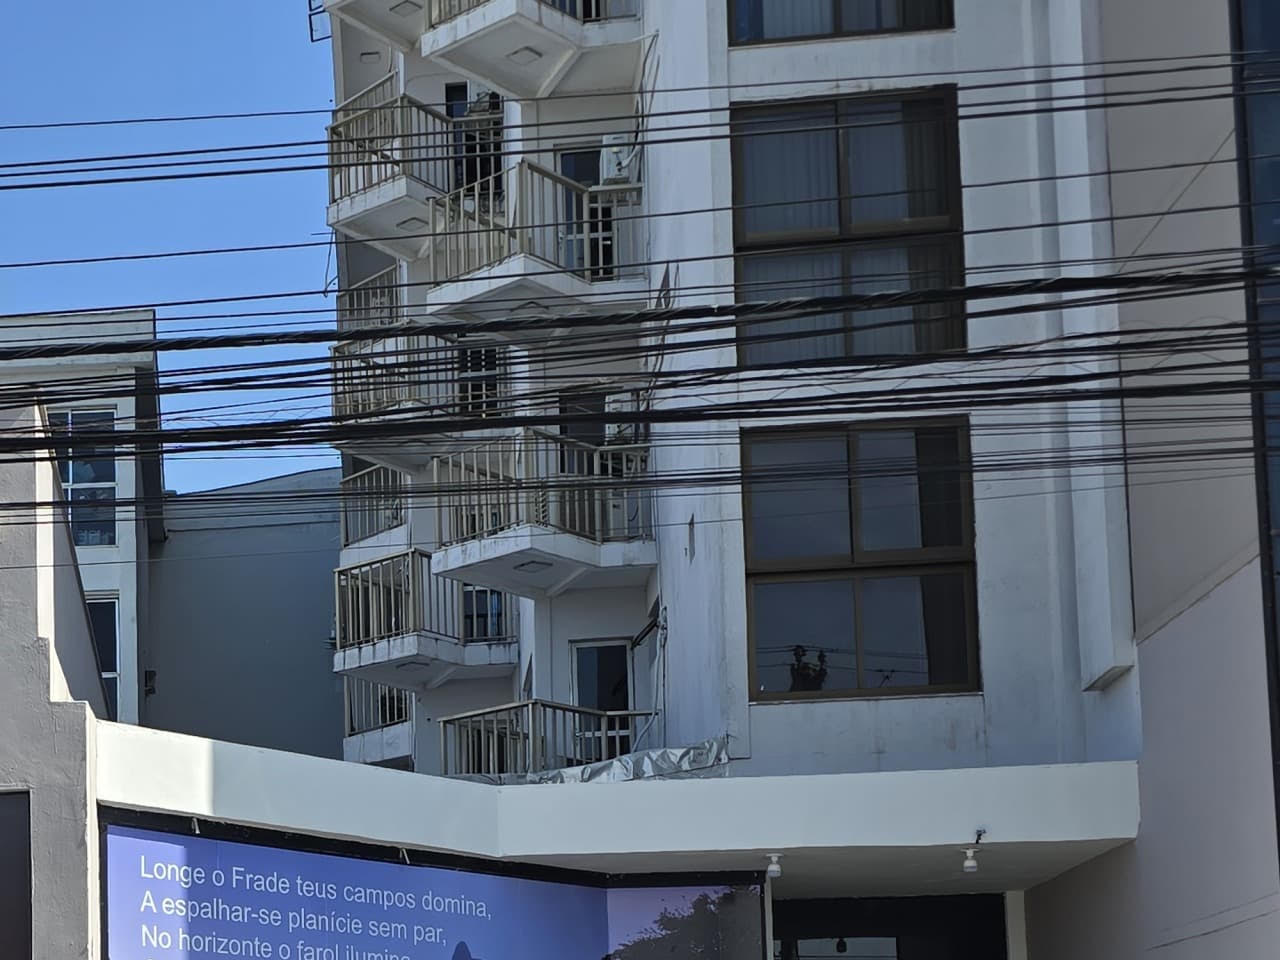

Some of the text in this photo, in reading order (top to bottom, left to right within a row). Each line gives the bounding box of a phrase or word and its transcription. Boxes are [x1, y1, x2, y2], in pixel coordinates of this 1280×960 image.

[141, 856, 491, 920] Longe o Frade teus campos domina,
[141, 891, 446, 946] A espalhar-se planície sem par,
[142, 925, 171, 948] No
[179, 928, 272, 958] horizonte
[279, 944, 290, 959] o
